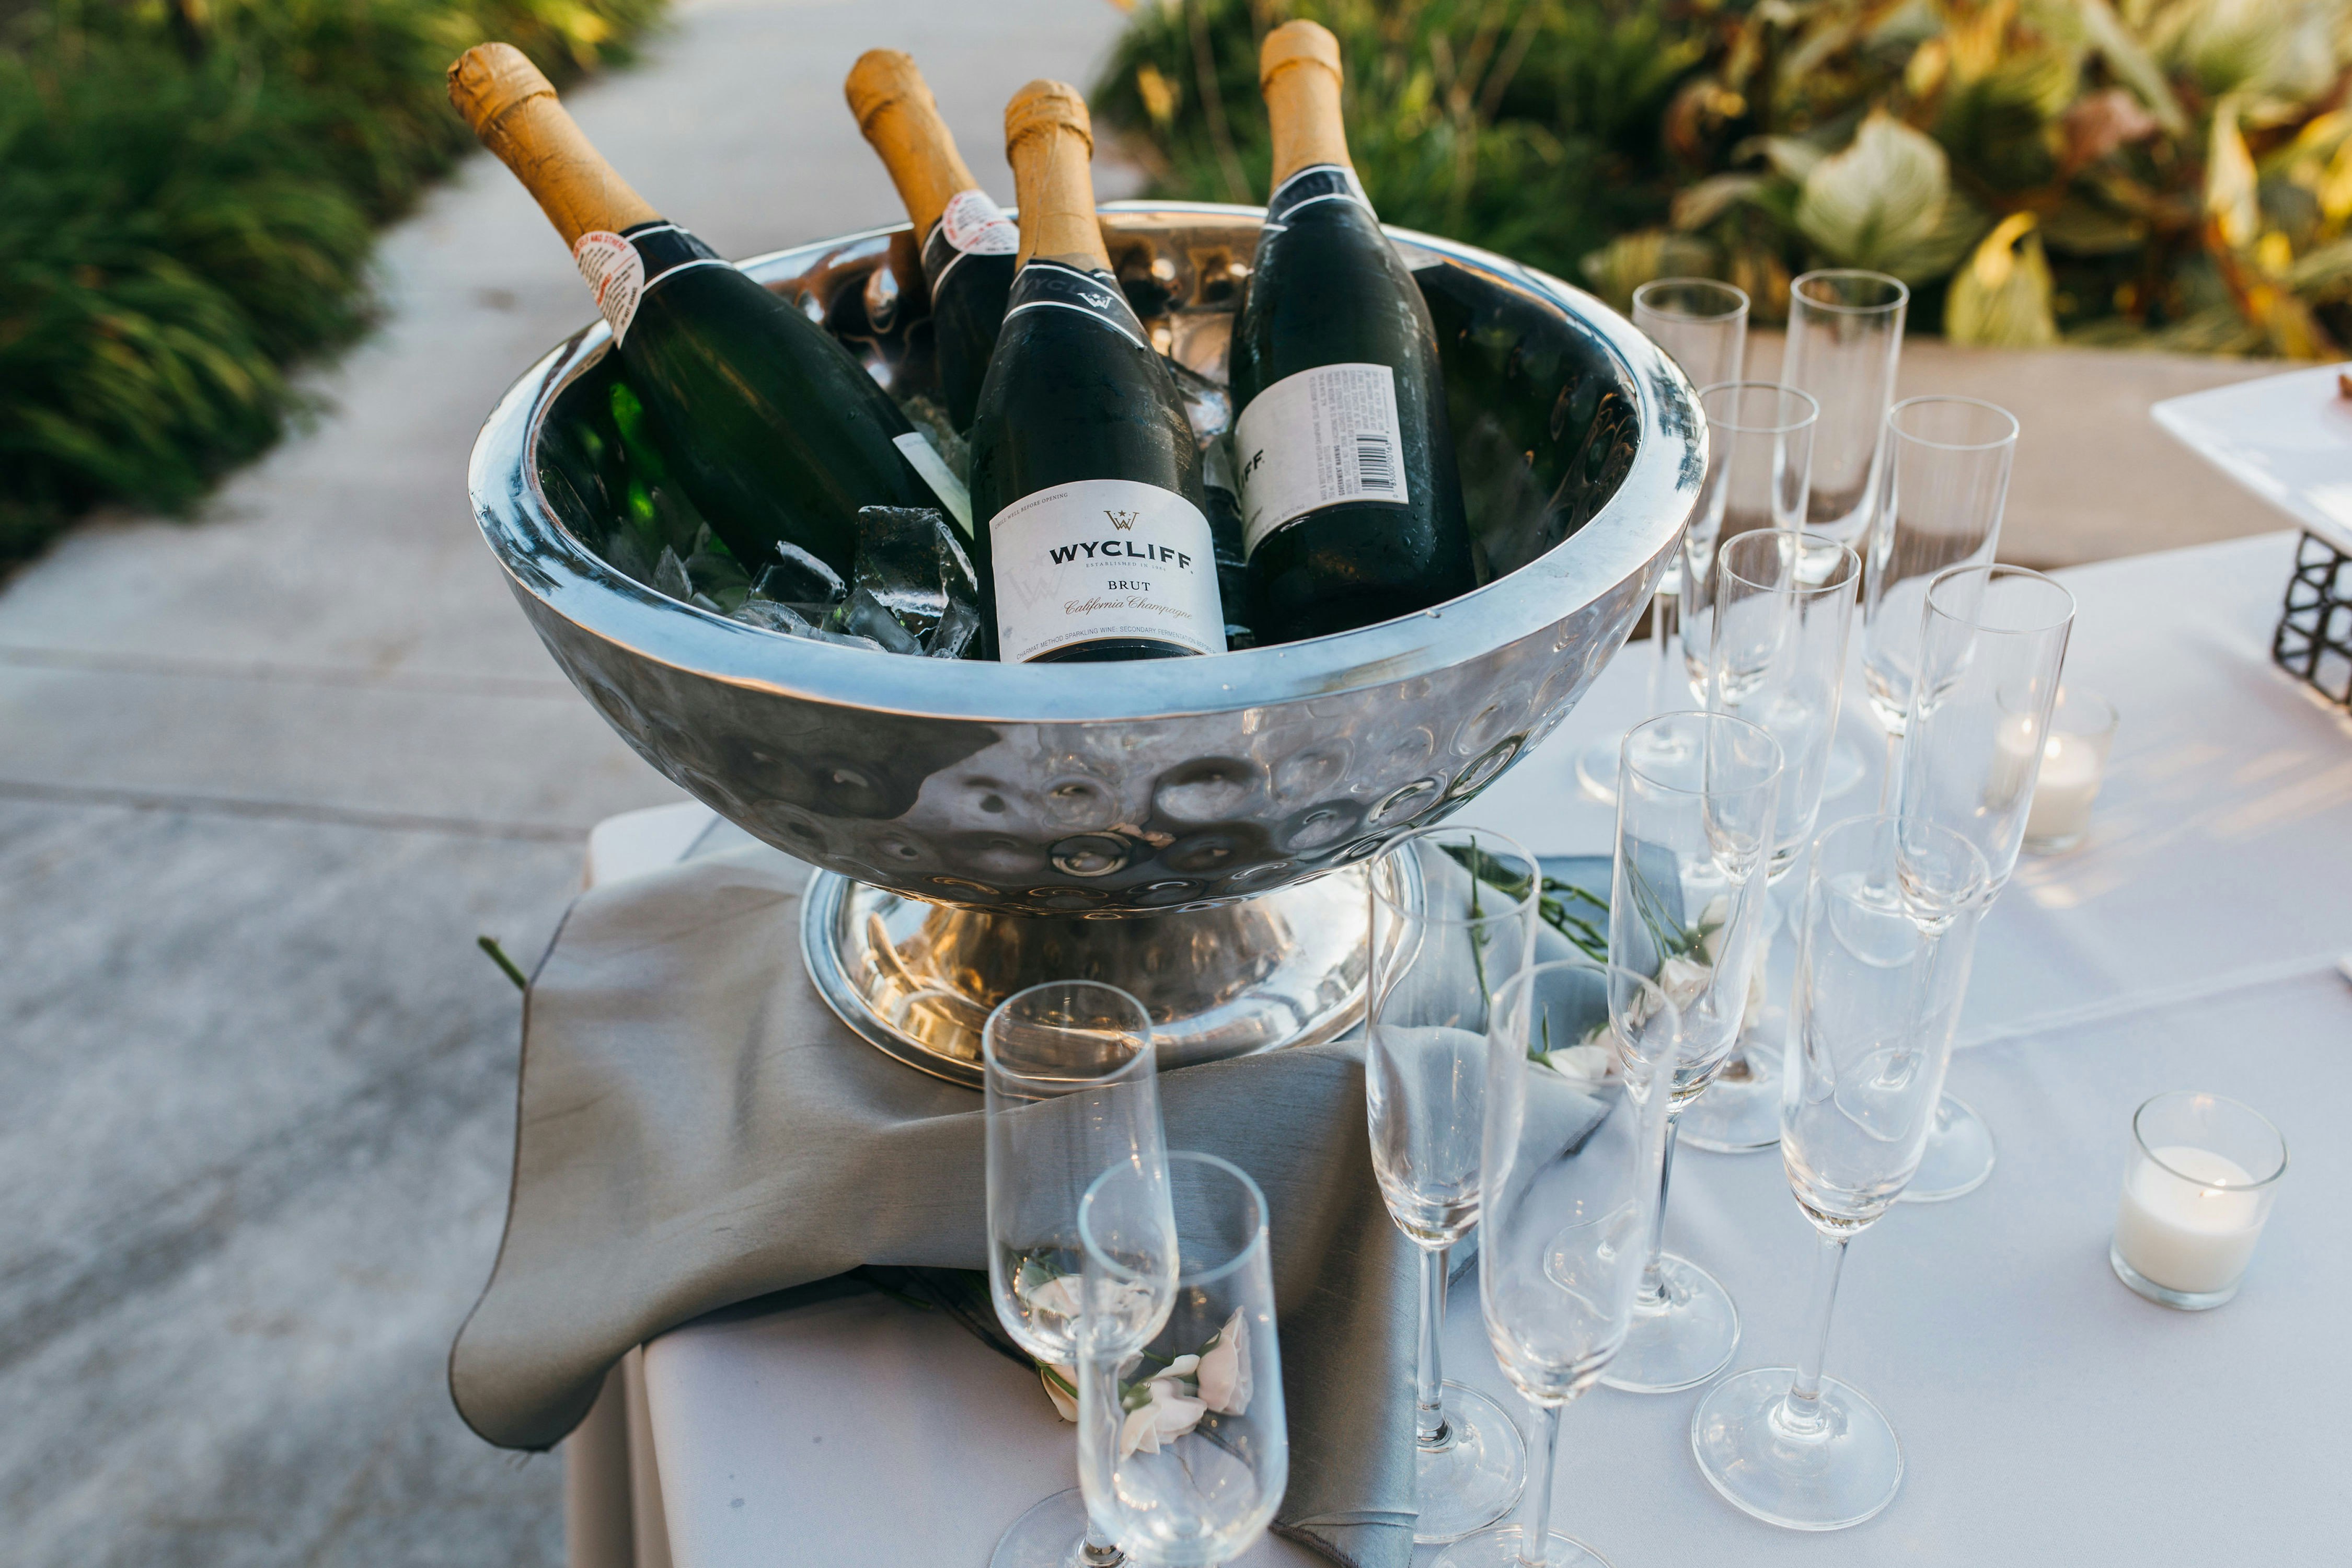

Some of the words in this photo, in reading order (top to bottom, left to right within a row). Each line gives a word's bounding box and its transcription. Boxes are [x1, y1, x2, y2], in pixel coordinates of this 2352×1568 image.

[1007, 510, 1020, 520] WELL
[1021, 500, 1041, 512] BEFORE
[1042, 492, 1068, 503] OPENING
[1049, 540, 1191, 569] WYCLIFF
[1108, 580, 1150, 592] BRUT
[1064, 596, 1125, 616] California
[1126, 595, 1193, 620] Champagne
[1016, 643, 1039, 660] CHARMAT
[1040, 635, 1064, 648] METHOD
[1065, 628, 1099, 640] SPARKLING
[1158, 629, 1196, 644] FERMENTATION
